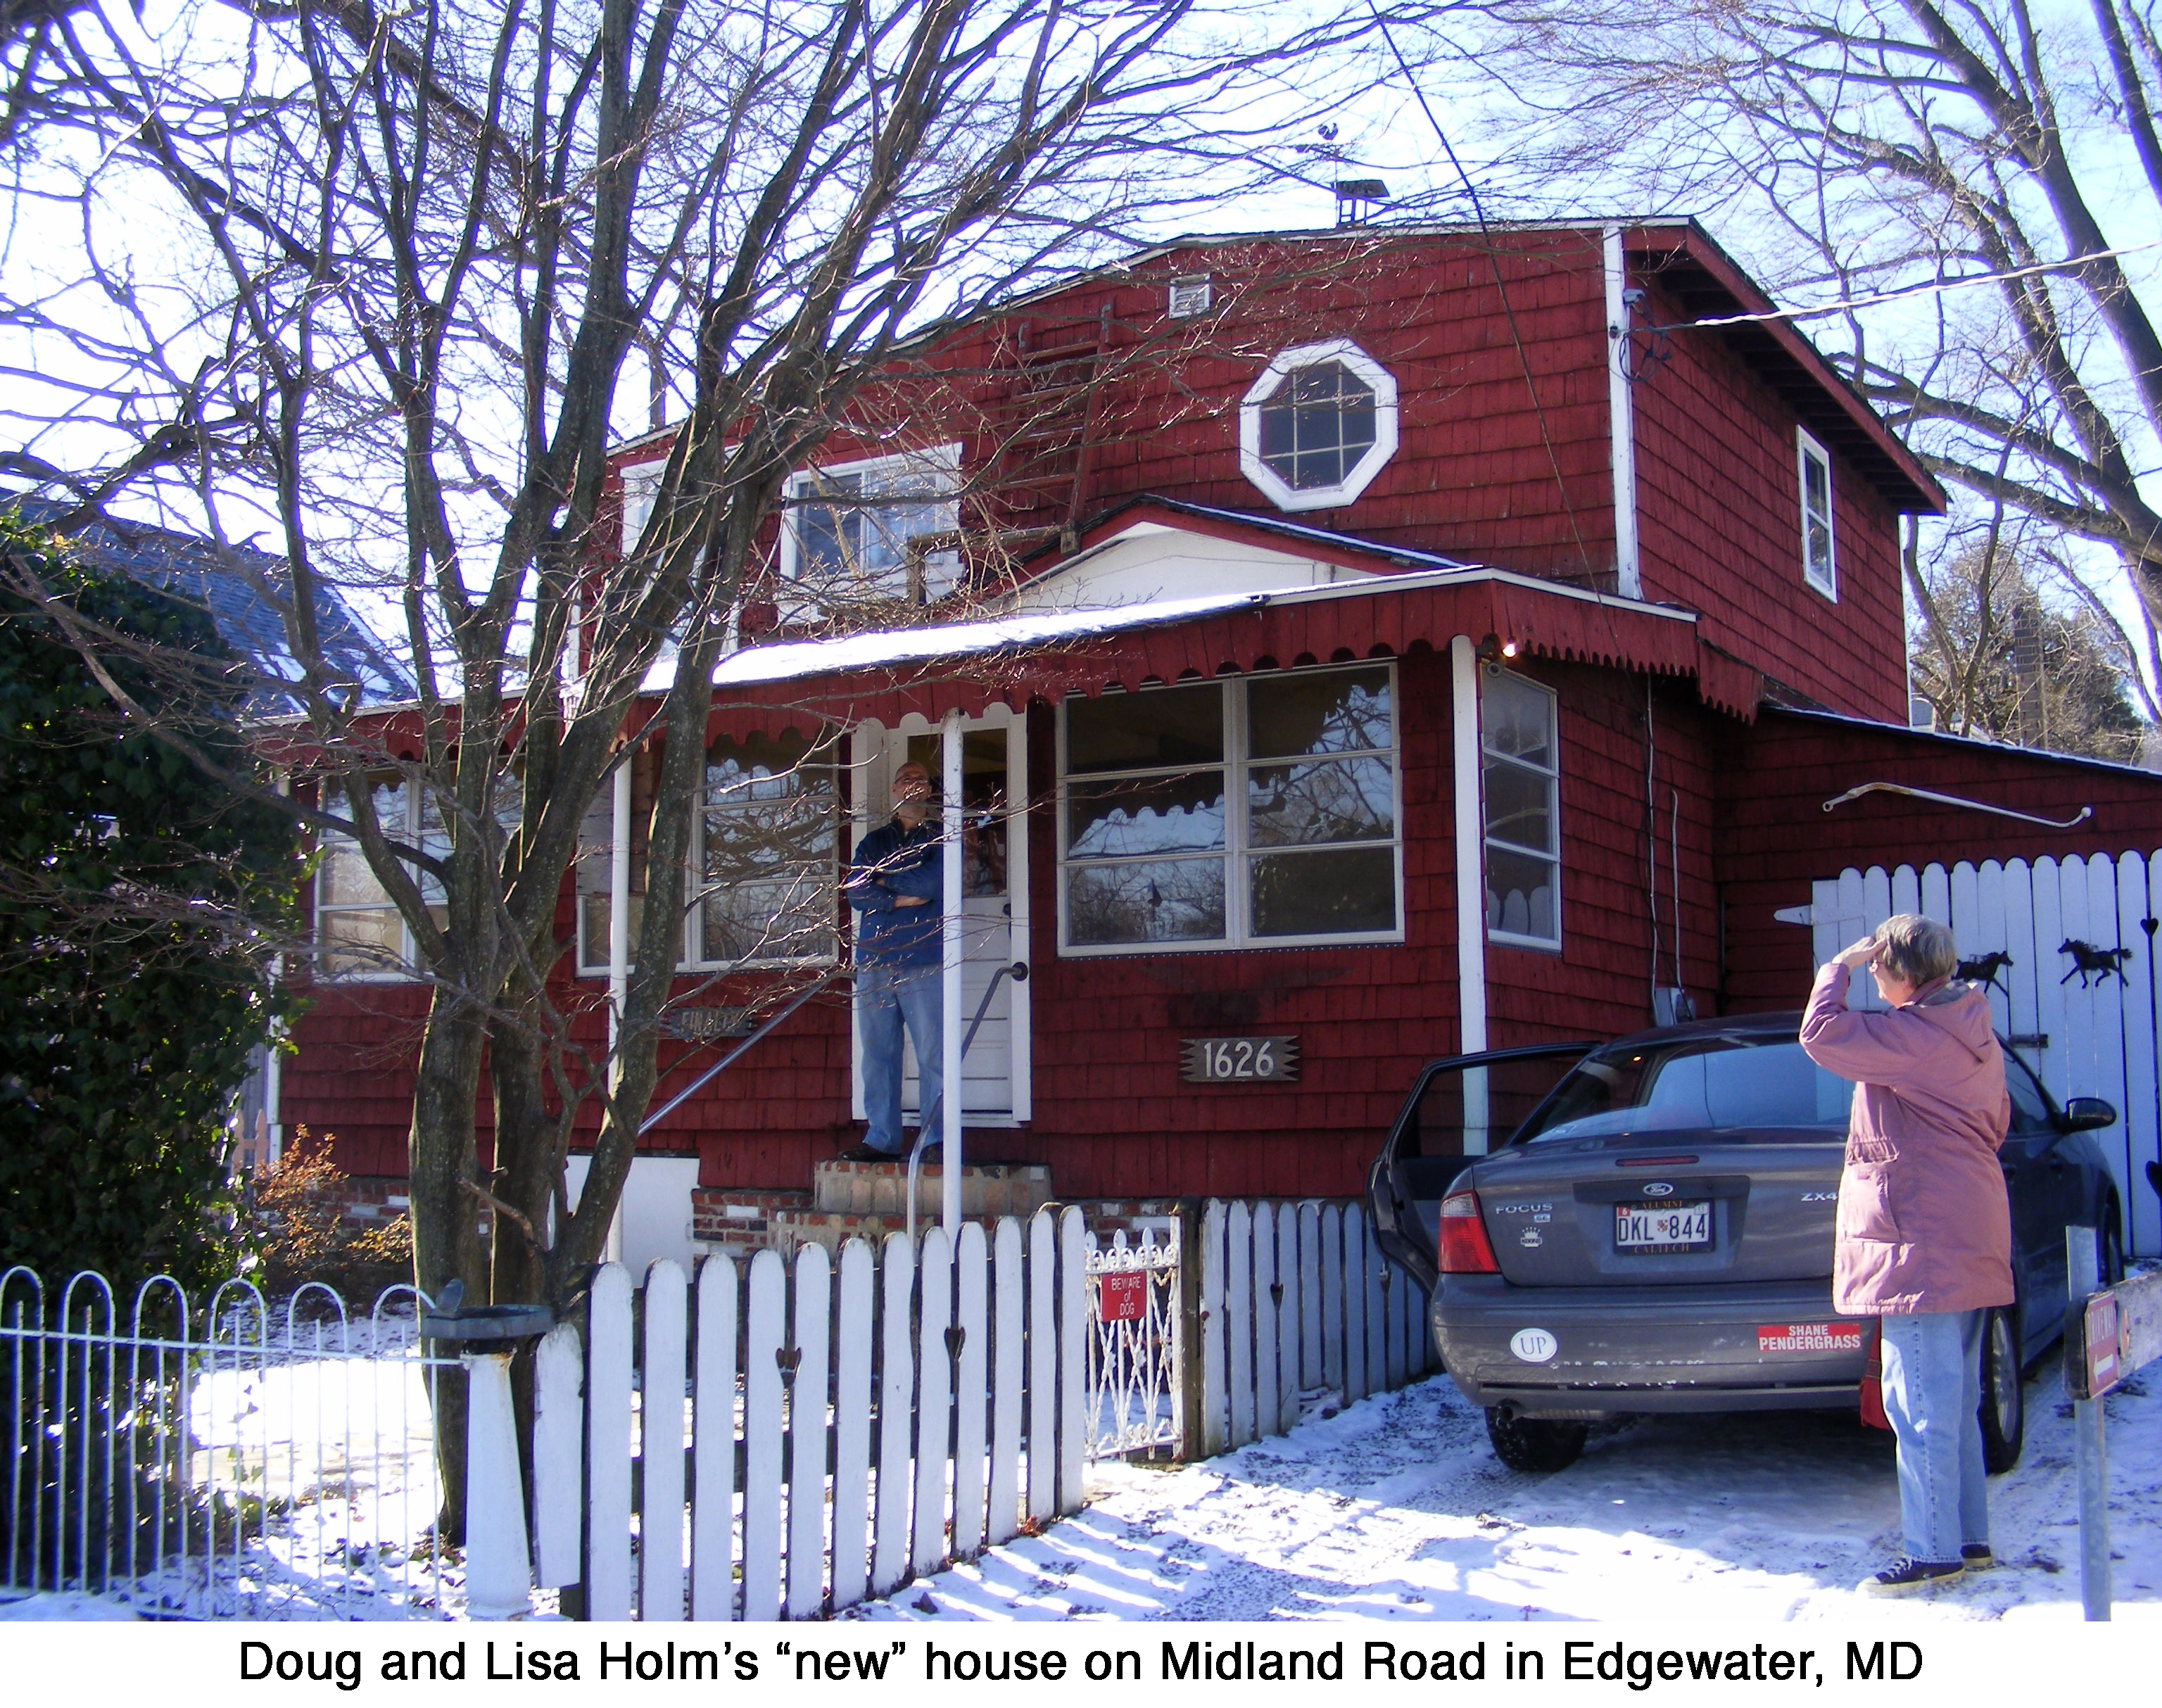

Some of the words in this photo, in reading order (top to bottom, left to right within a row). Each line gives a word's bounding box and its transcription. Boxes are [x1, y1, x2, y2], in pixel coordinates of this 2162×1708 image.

[1204, 1040, 1274, 1078] 1626
[1800, 1192, 1838, 1202] ZX4
[1496, 1203, 1553, 1215] FOCUS
[1641, 1200, 1683, 1210] ALUMNI
[1619, 1216, 1654, 1242] DKL
[1669, 1214, 1706, 1239] 844
[1633, 1244, 1690, 1255] CALTECH
[1111, 1277, 1142, 1291] BEWARE
[1123, 1289, 1131, 1303] of
[1120, 1302, 1135, 1316] DOG
[1788, 1324, 1828, 1336] SHANE
[1519, 1336, 1546, 1355] UP
[1759, 1334, 1861, 1350] PENDERGRASS
